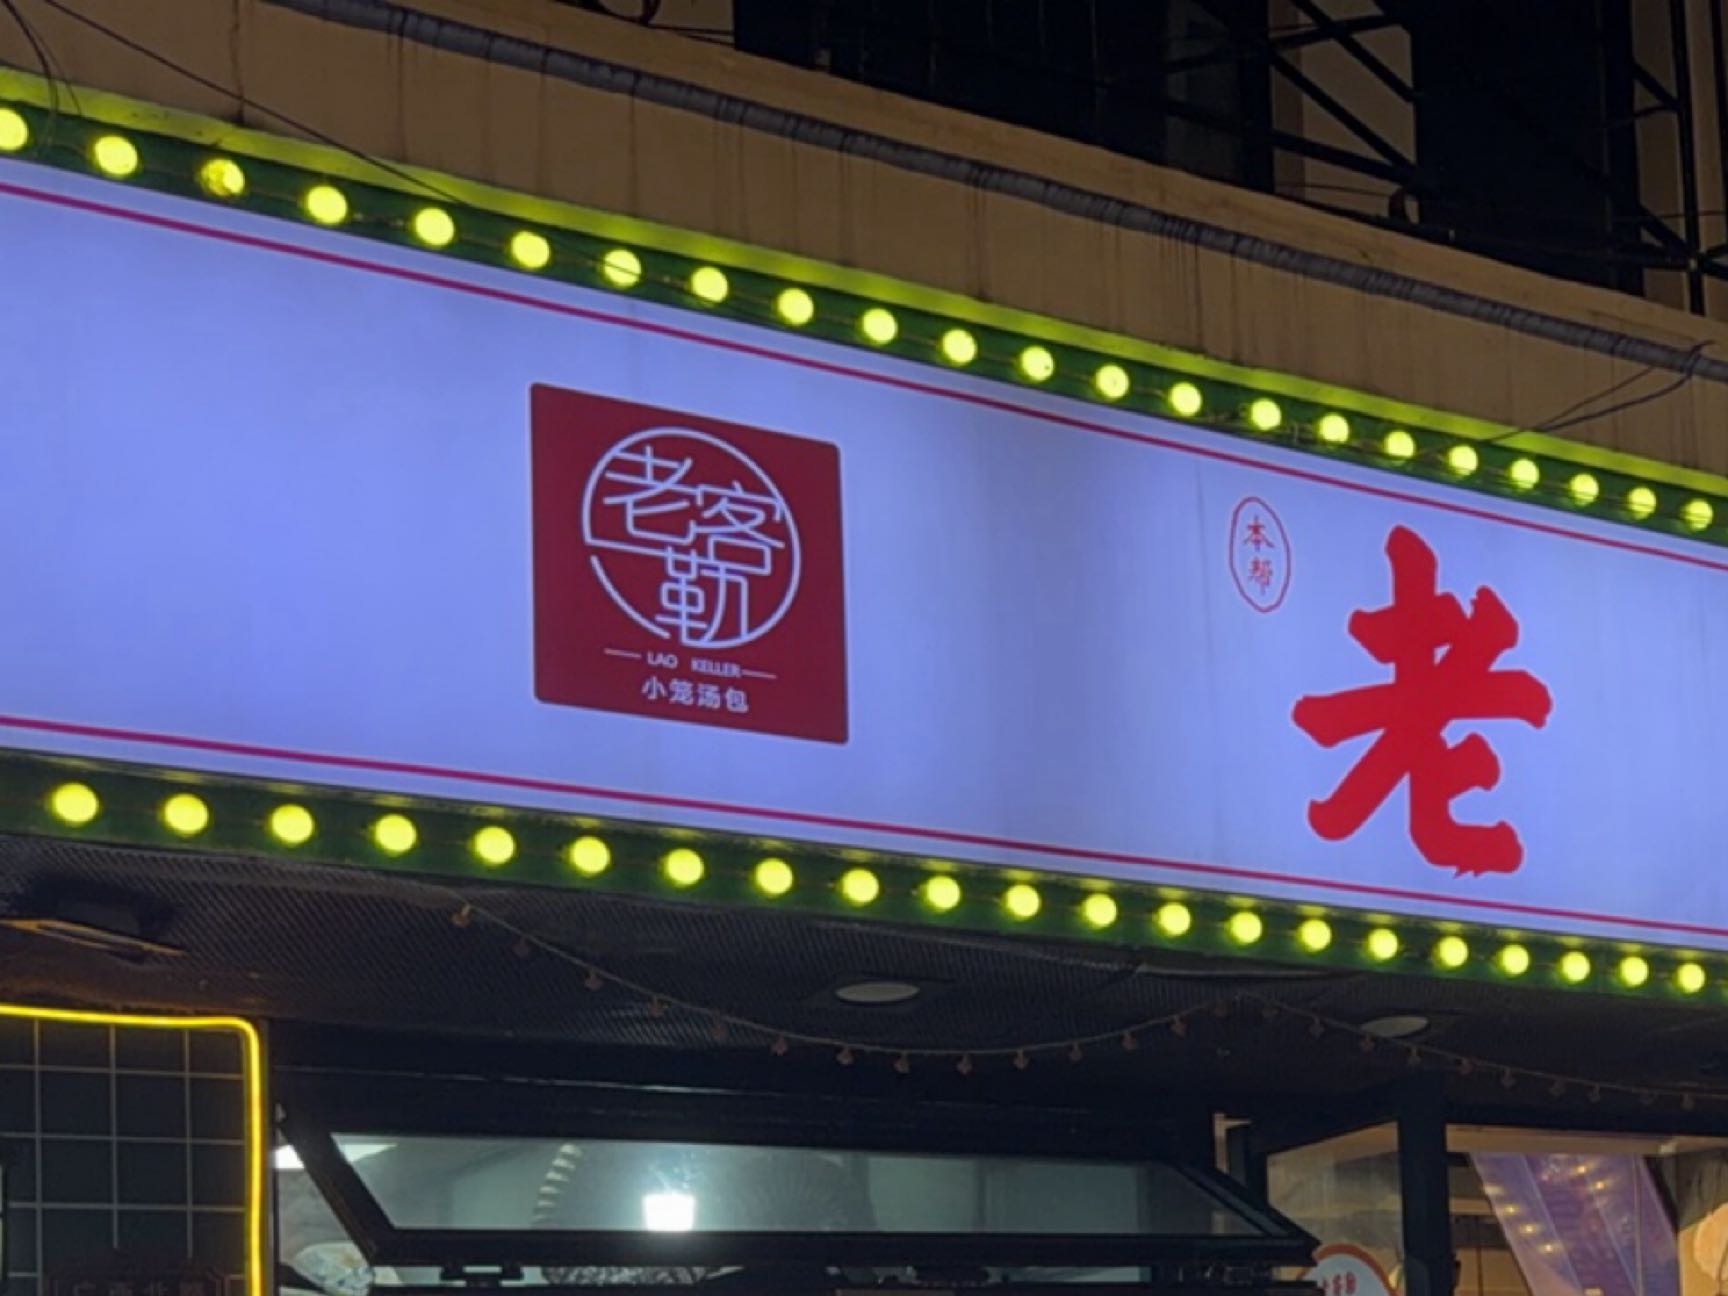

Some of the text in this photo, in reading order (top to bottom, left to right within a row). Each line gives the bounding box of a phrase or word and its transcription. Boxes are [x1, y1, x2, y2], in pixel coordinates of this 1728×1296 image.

[647, 651, 679, 669] LAO
[640, 676, 750, 714] 小笼汤包
